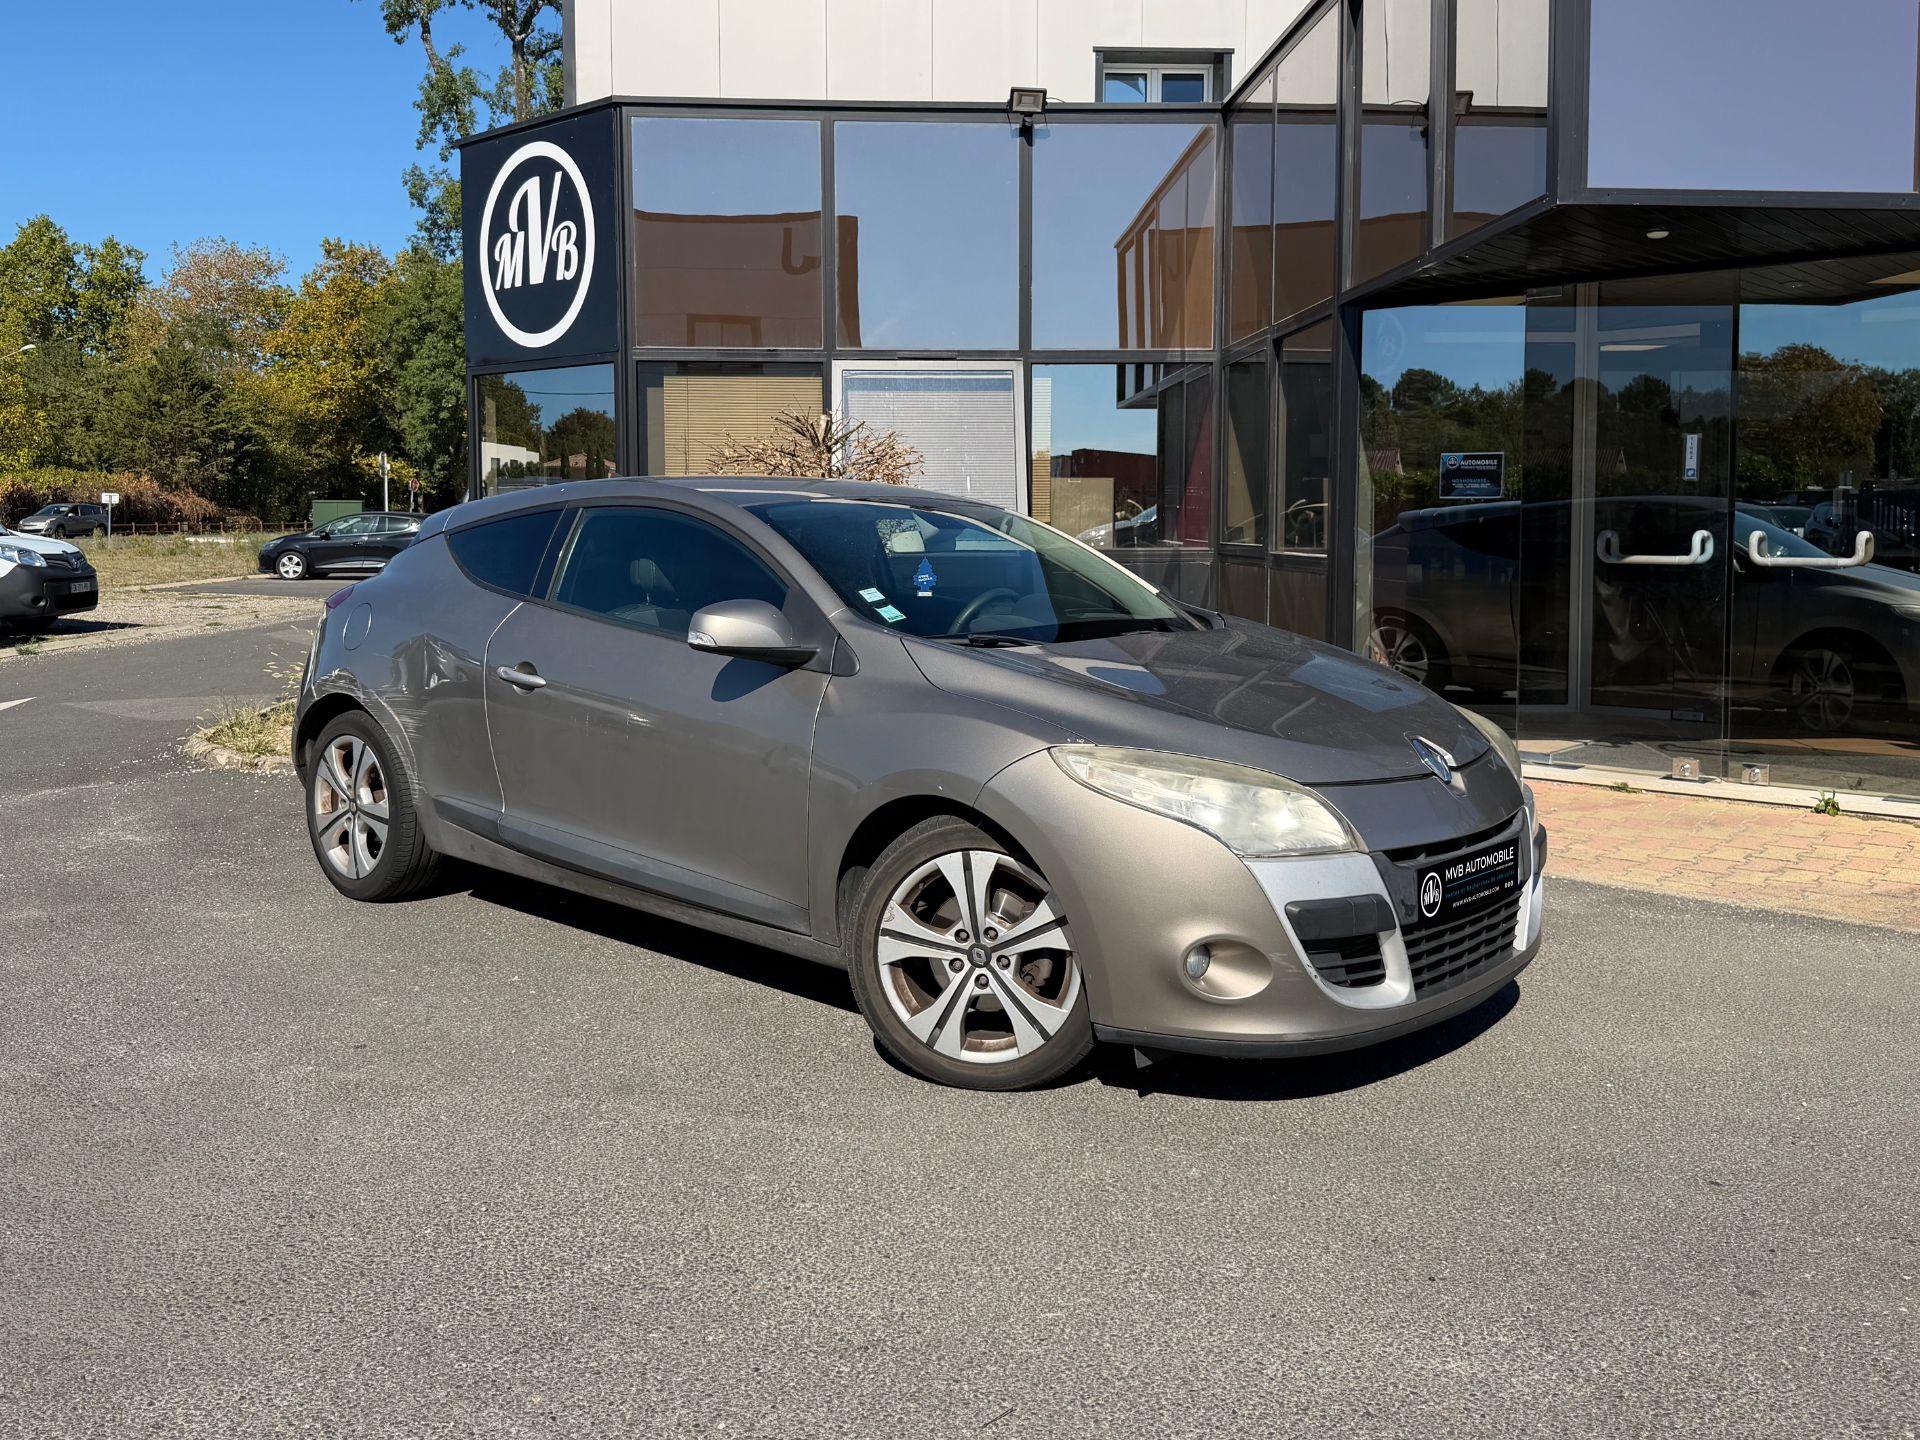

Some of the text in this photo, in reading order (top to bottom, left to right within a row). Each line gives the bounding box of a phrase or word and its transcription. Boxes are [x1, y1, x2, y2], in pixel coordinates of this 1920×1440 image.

[494, 170, 579, 291] MVB
[1445, 846, 1514, 881] MVB AUTOMOBILE
[1423, 878, 1440, 906] MVB
